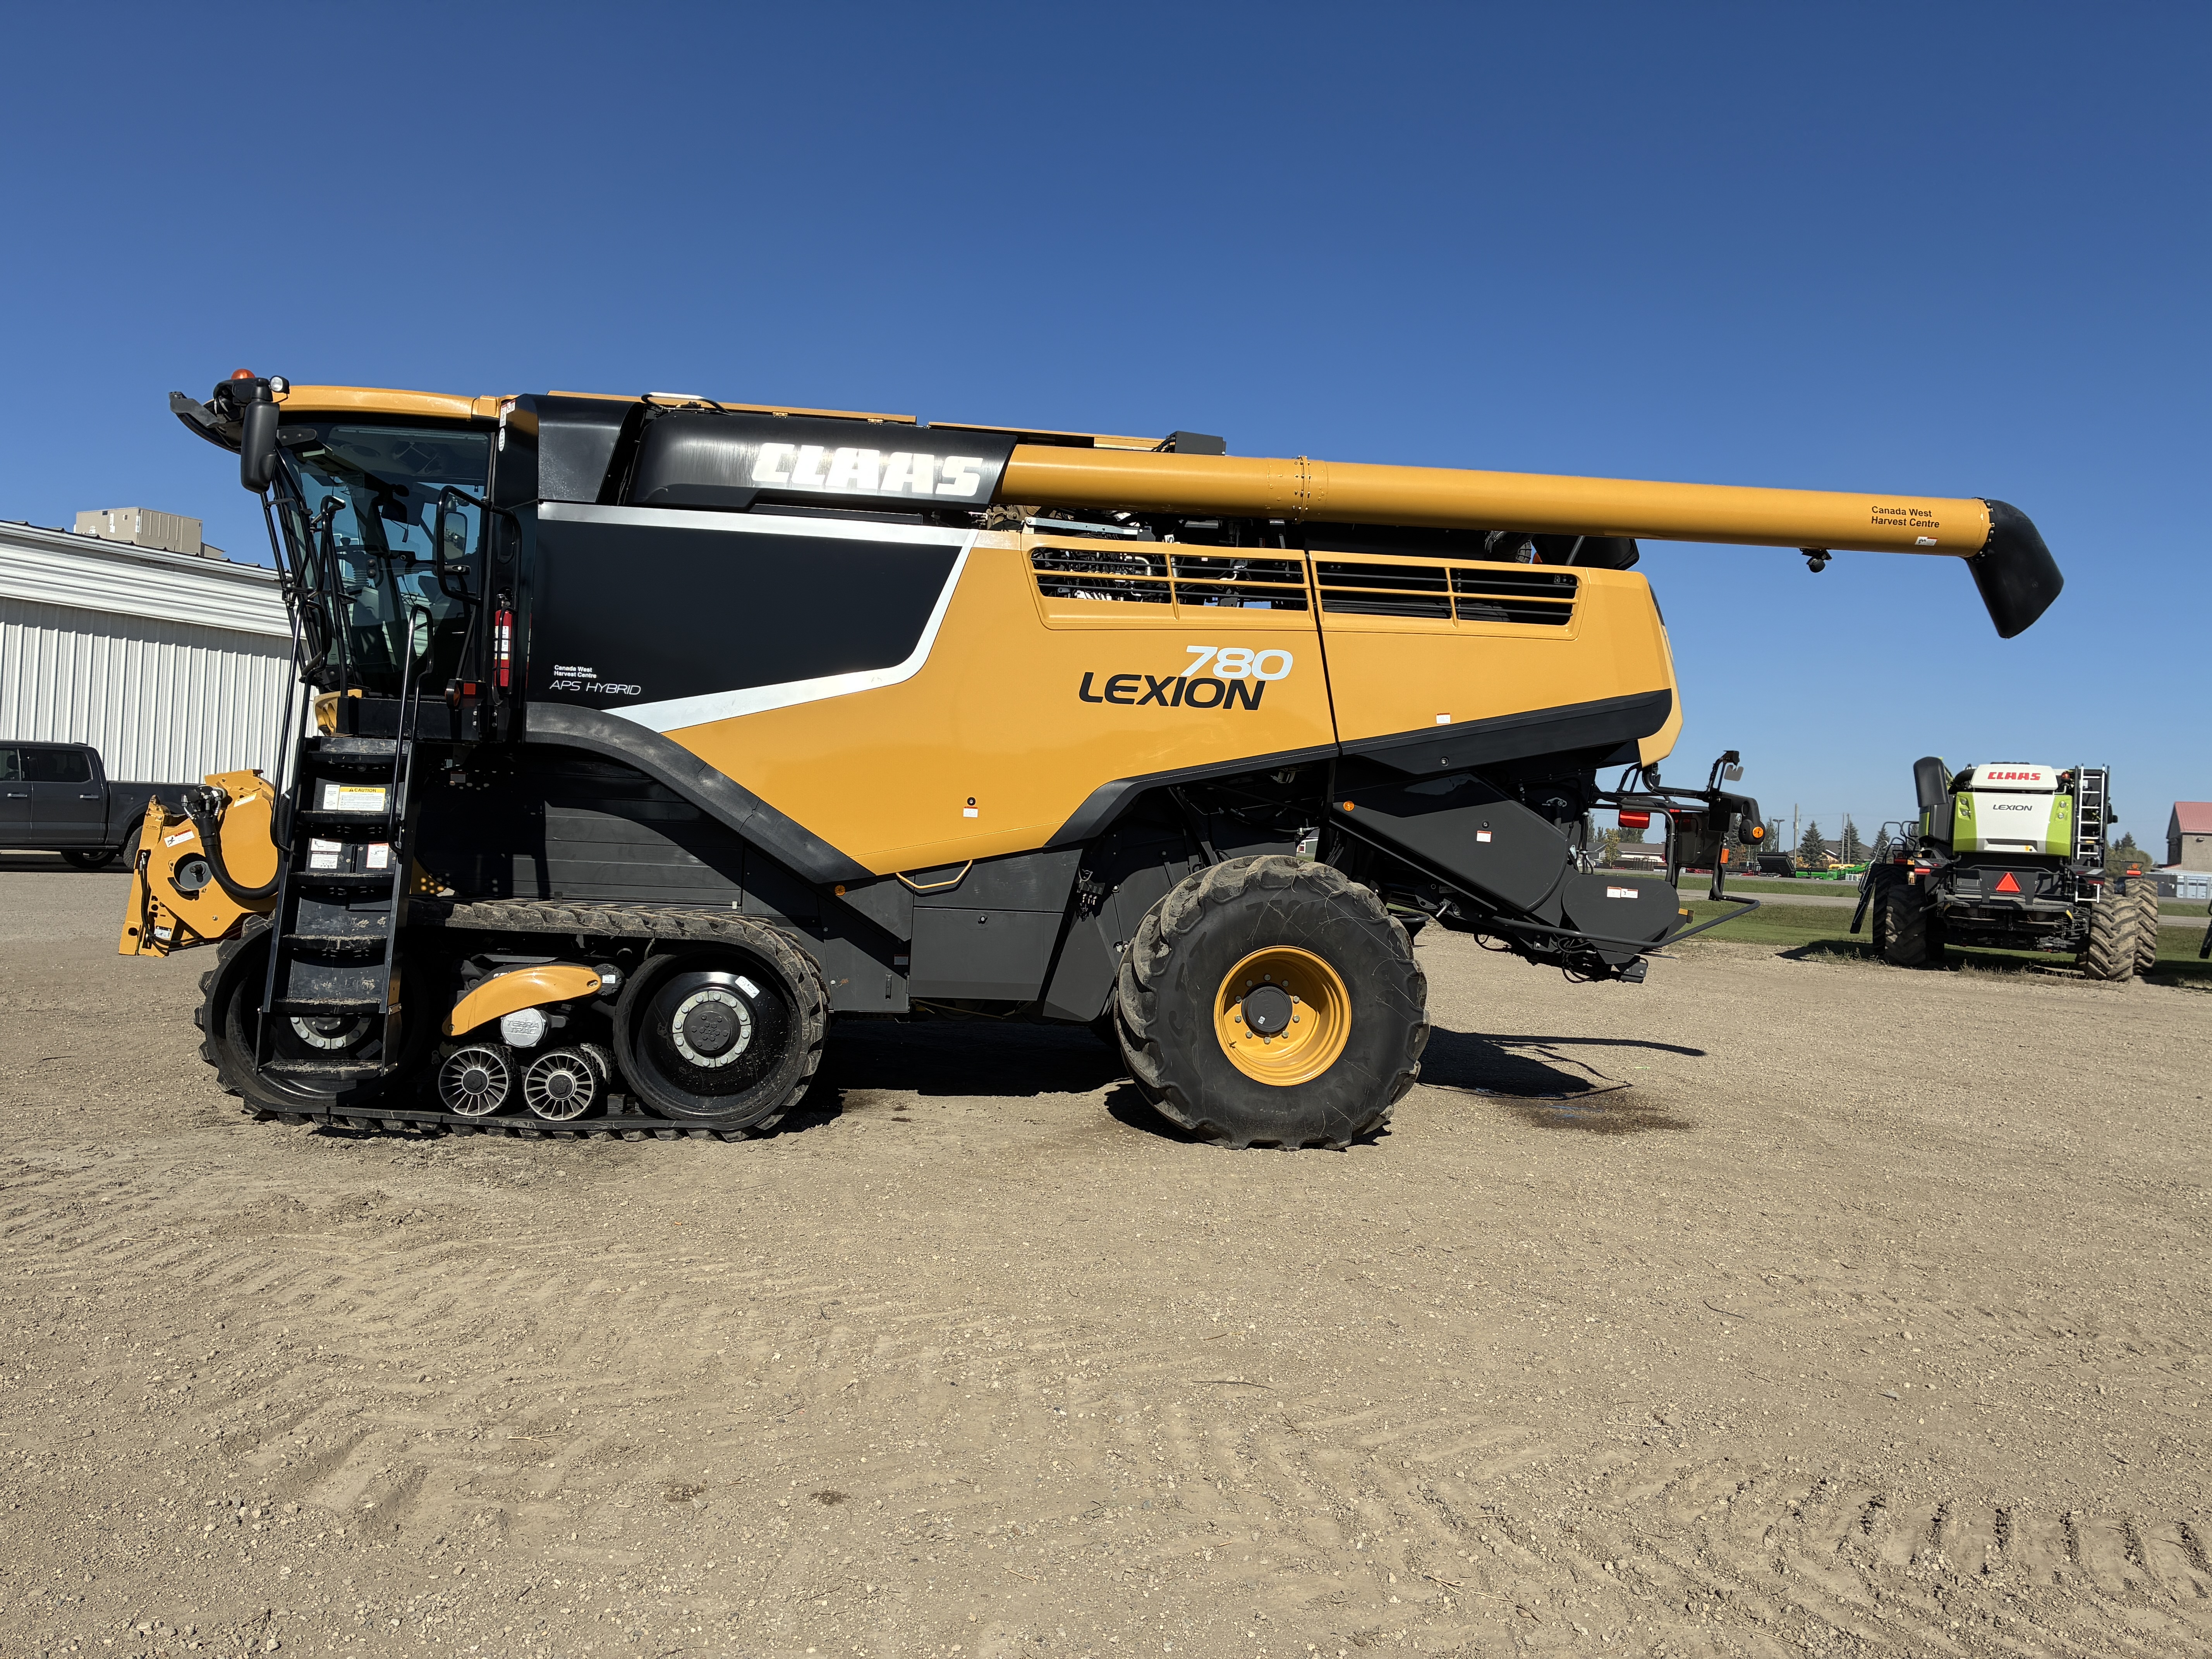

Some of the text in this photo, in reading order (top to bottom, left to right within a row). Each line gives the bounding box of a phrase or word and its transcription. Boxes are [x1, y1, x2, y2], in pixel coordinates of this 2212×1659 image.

[751, 442, 984, 496] CLAAS
[1872, 506, 1932, 517] Canada West
[1871, 516, 1940, 528] Harvest Centre
[1181, 645, 1293, 680] 780
[549, 680, 641, 695] APS HYBRID
[1079, 672, 1266, 710] LEXION
[1987, 772, 2041, 780] CLAAS
[507, 1020, 539, 1029] TERRA
